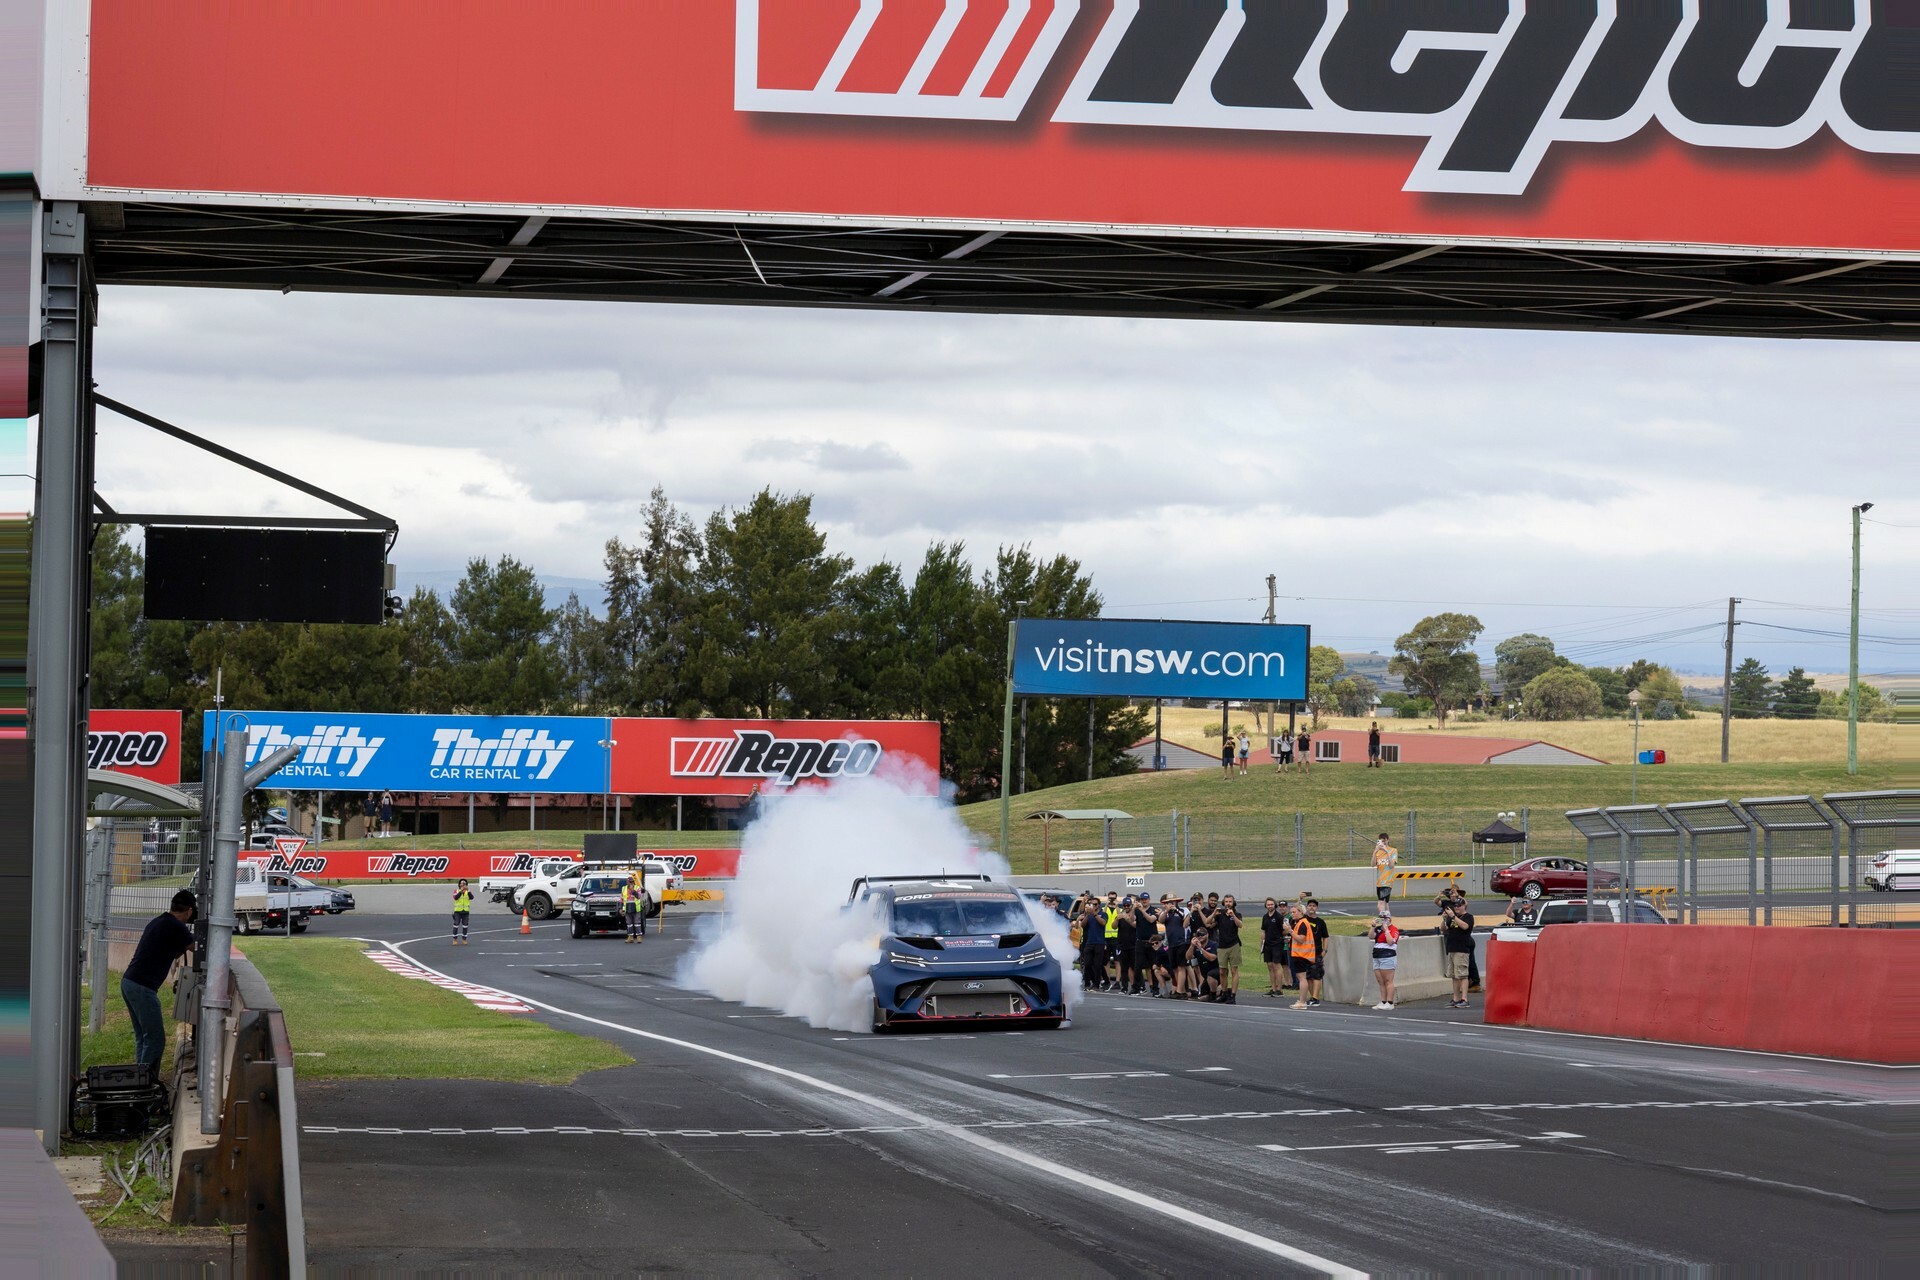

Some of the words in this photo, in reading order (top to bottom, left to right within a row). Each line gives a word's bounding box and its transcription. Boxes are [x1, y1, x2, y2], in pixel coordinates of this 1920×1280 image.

[1034, 638, 1285, 677] visitnsw.com
[430, 728, 574, 780] Thrifty
[719, 729, 882, 786] Repco
[430, 768, 460, 779] CAR
[464, 768, 521, 780] RENTAL
[387, 853, 449, 875] Repco
[896, 893, 933, 902] FORD
